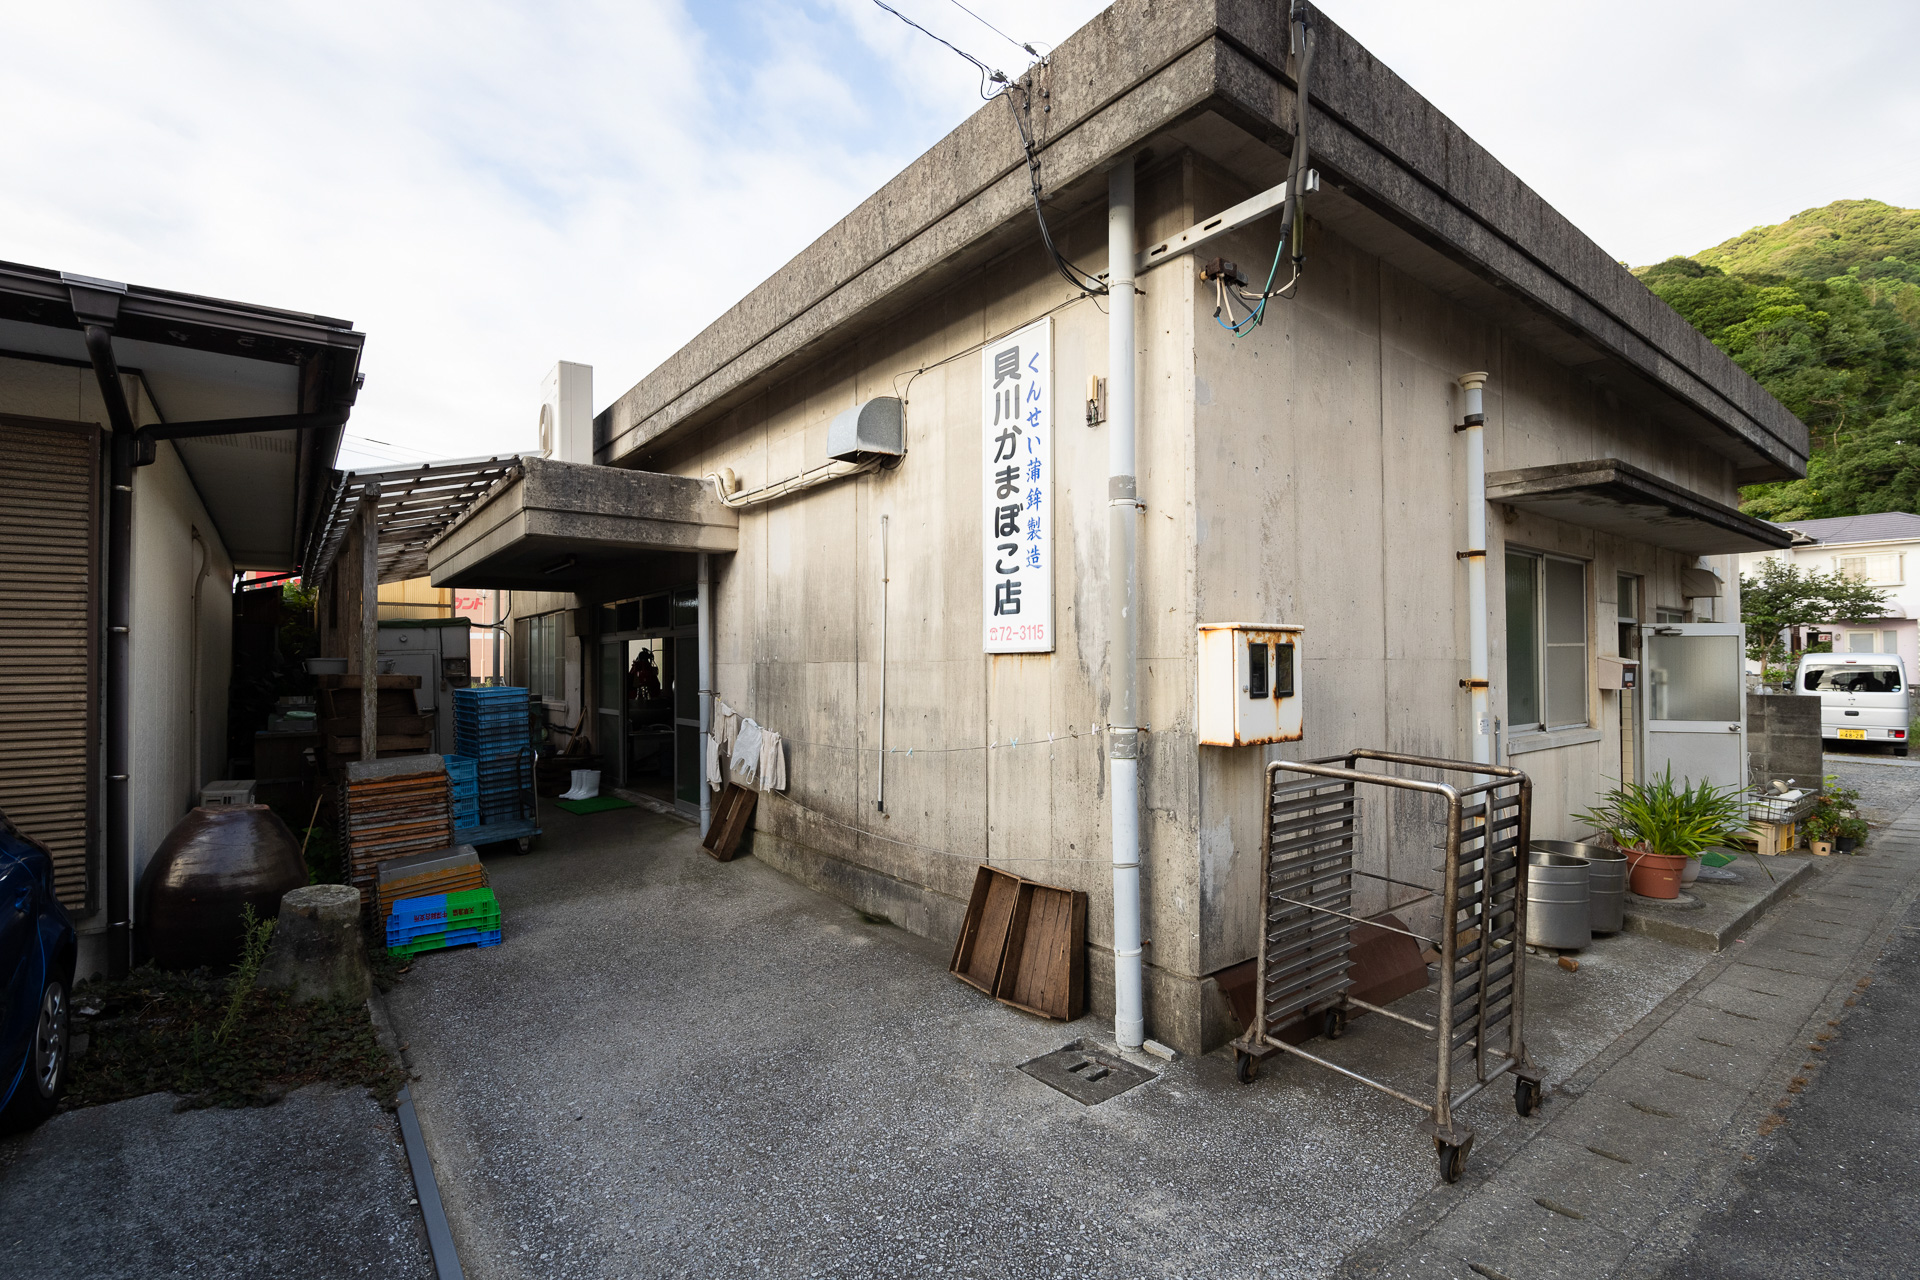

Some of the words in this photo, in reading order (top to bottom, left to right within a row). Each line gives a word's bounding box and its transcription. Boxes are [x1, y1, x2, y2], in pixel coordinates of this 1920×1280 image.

[993, 345, 1023, 617] 貝川かまぼこ店
[1026, 352, 1043, 569] くんせい蒲鉾製造
[999, 624, 1044, 641] 72-3115
